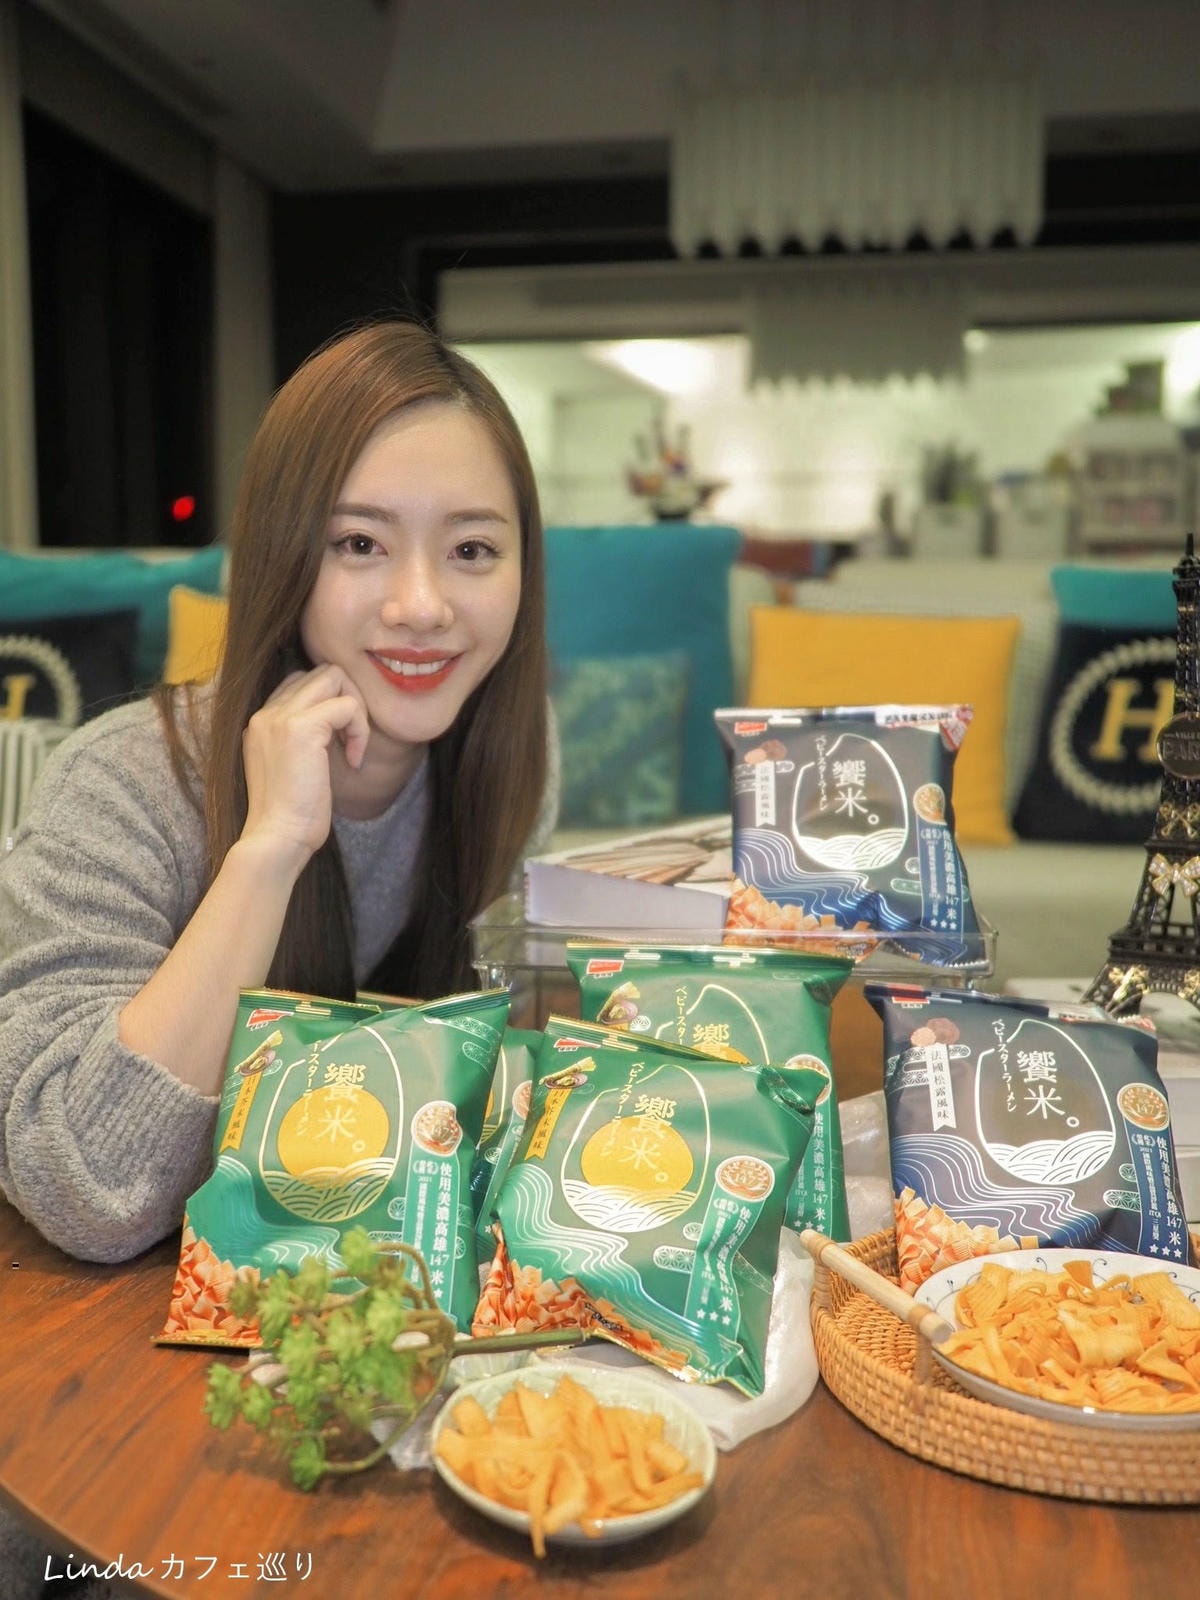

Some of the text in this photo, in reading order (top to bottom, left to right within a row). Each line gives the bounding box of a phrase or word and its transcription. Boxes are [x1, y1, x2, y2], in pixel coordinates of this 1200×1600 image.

[992, 1018, 1017, 1112] ベビースターラーメン
